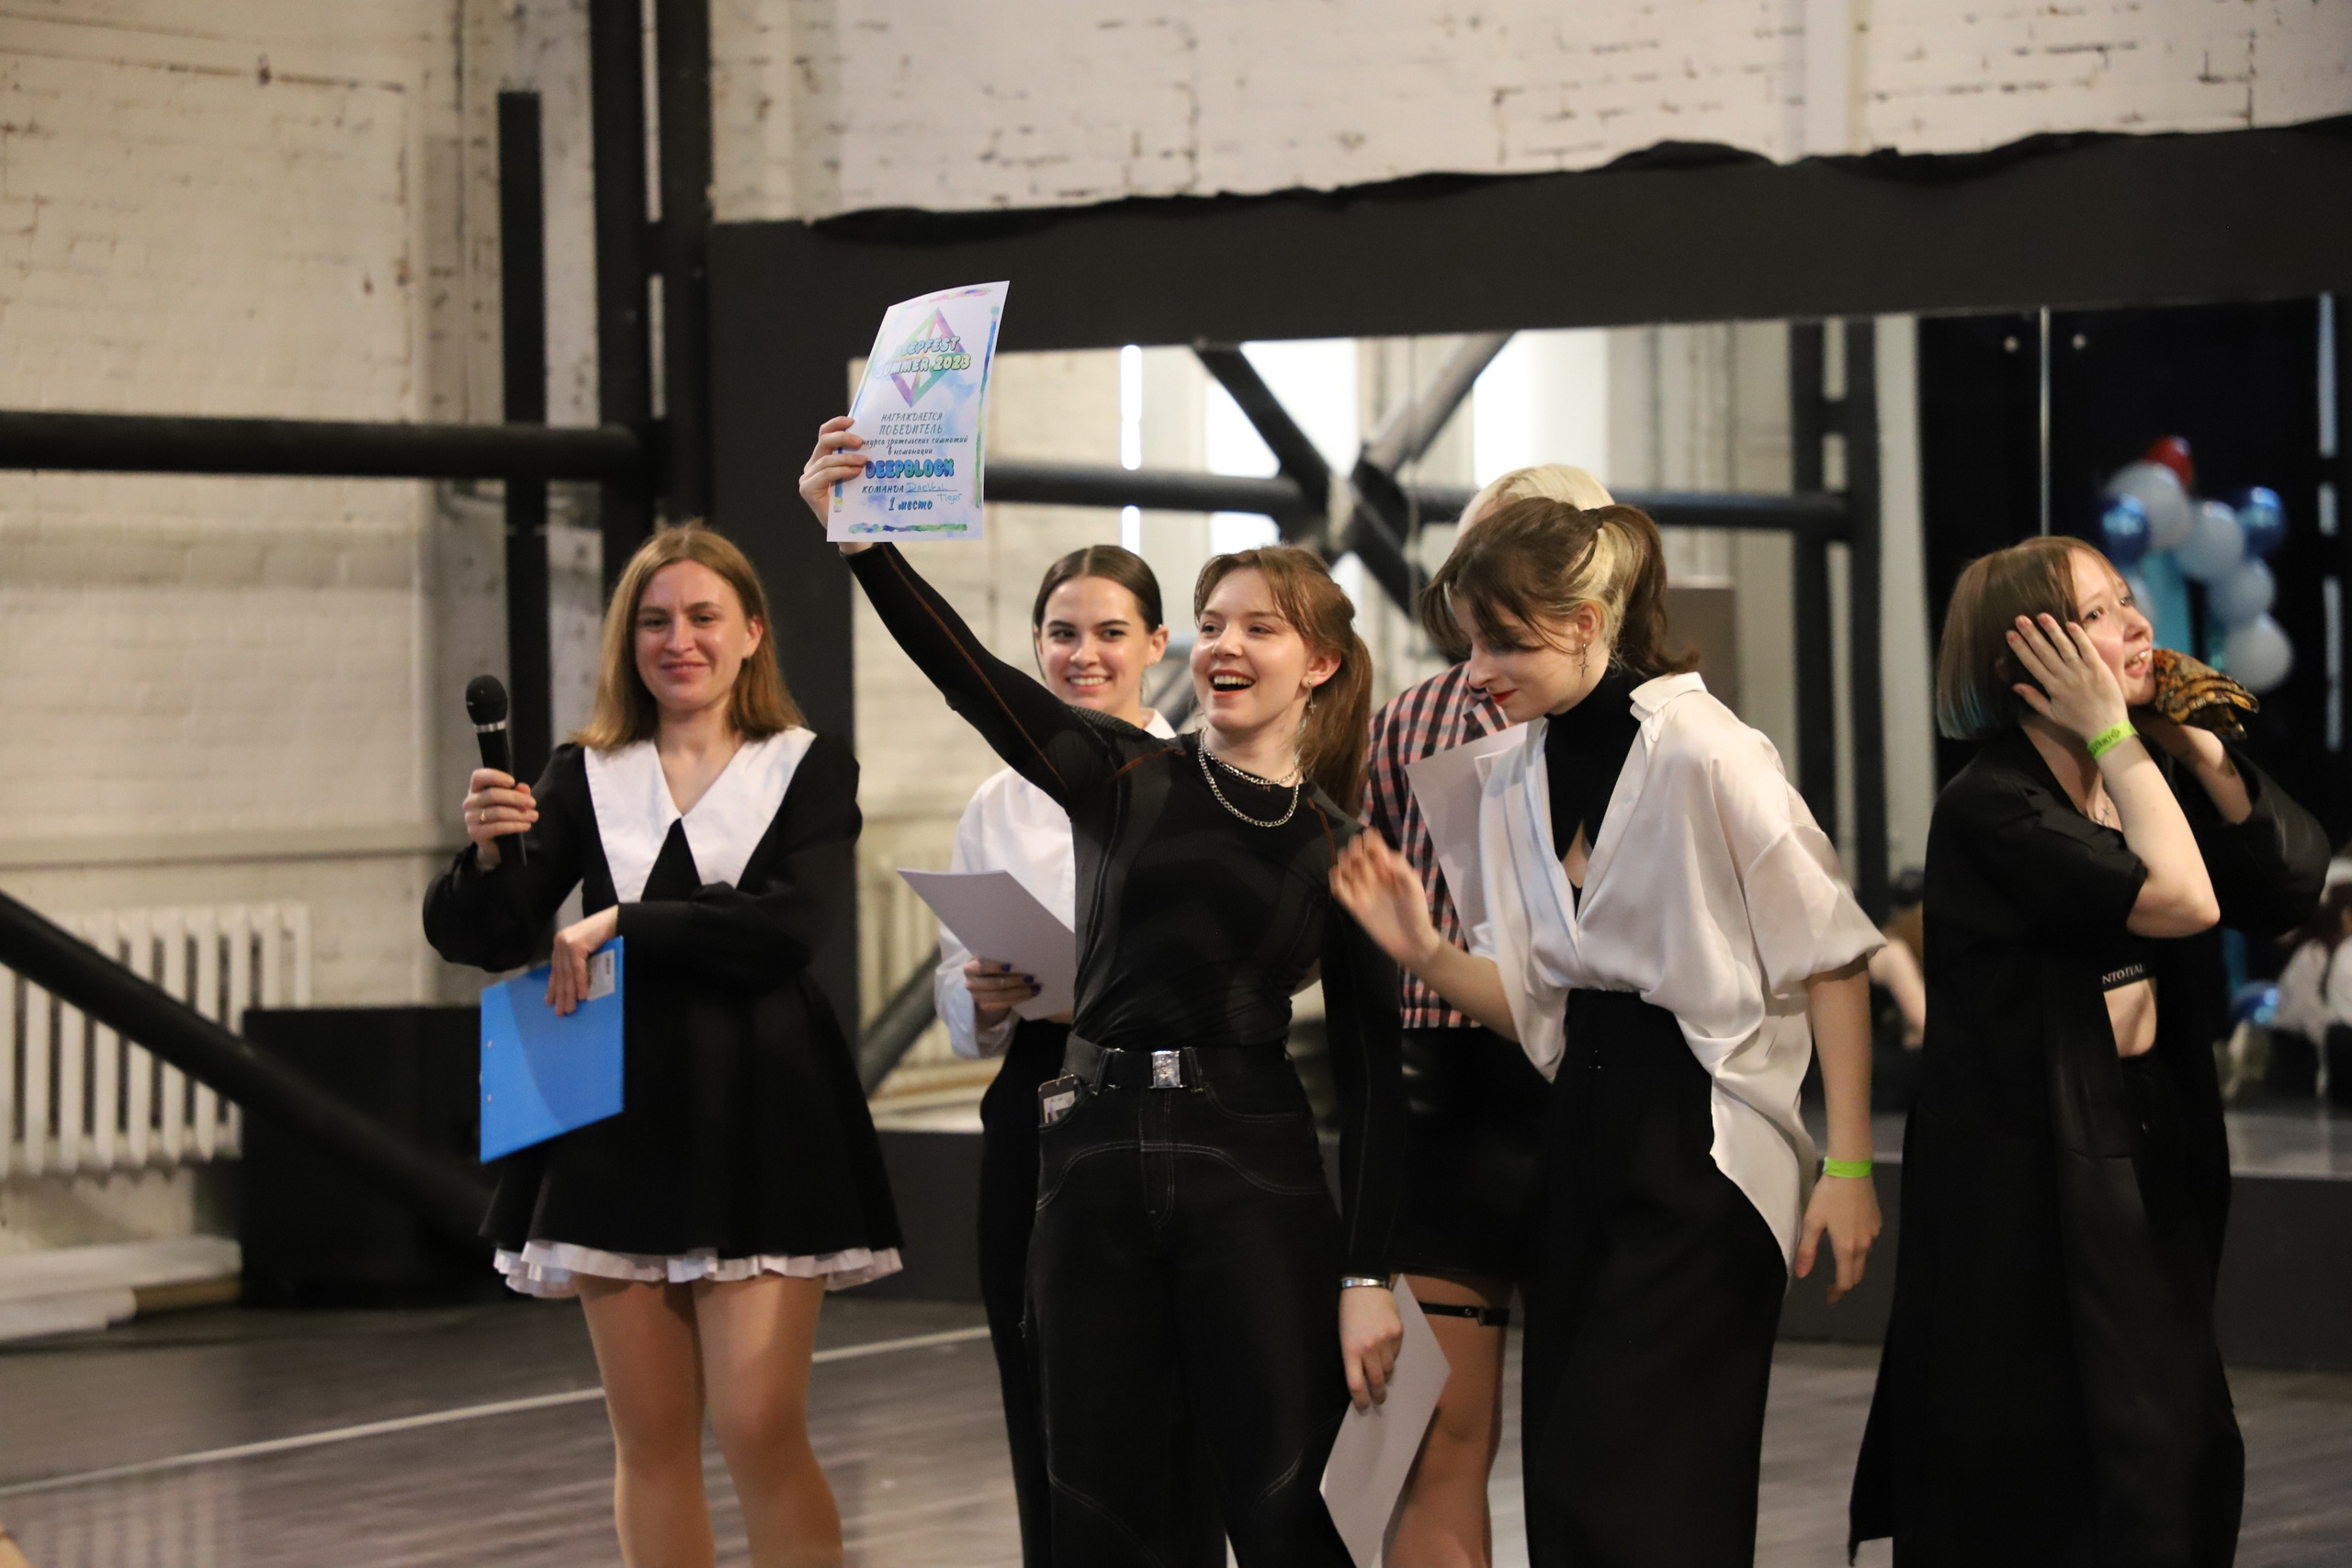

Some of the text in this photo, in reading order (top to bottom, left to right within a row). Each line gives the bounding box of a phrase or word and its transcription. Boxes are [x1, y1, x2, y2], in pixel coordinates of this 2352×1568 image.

[895, 335, 961, 357] DEEPFEST
[876, 353, 971, 378] SUMMER 2023
[880, 412, 944, 423] НАГРАЖДАЕТСЯ
[878, 423, 943, 436] ПОБЕДИТЕЛЬ
[865, 458, 955, 479] DEEPBLOCK
[862, 485, 904, 494] КОМАНДА
[888, 497, 933, 511] 1 место
